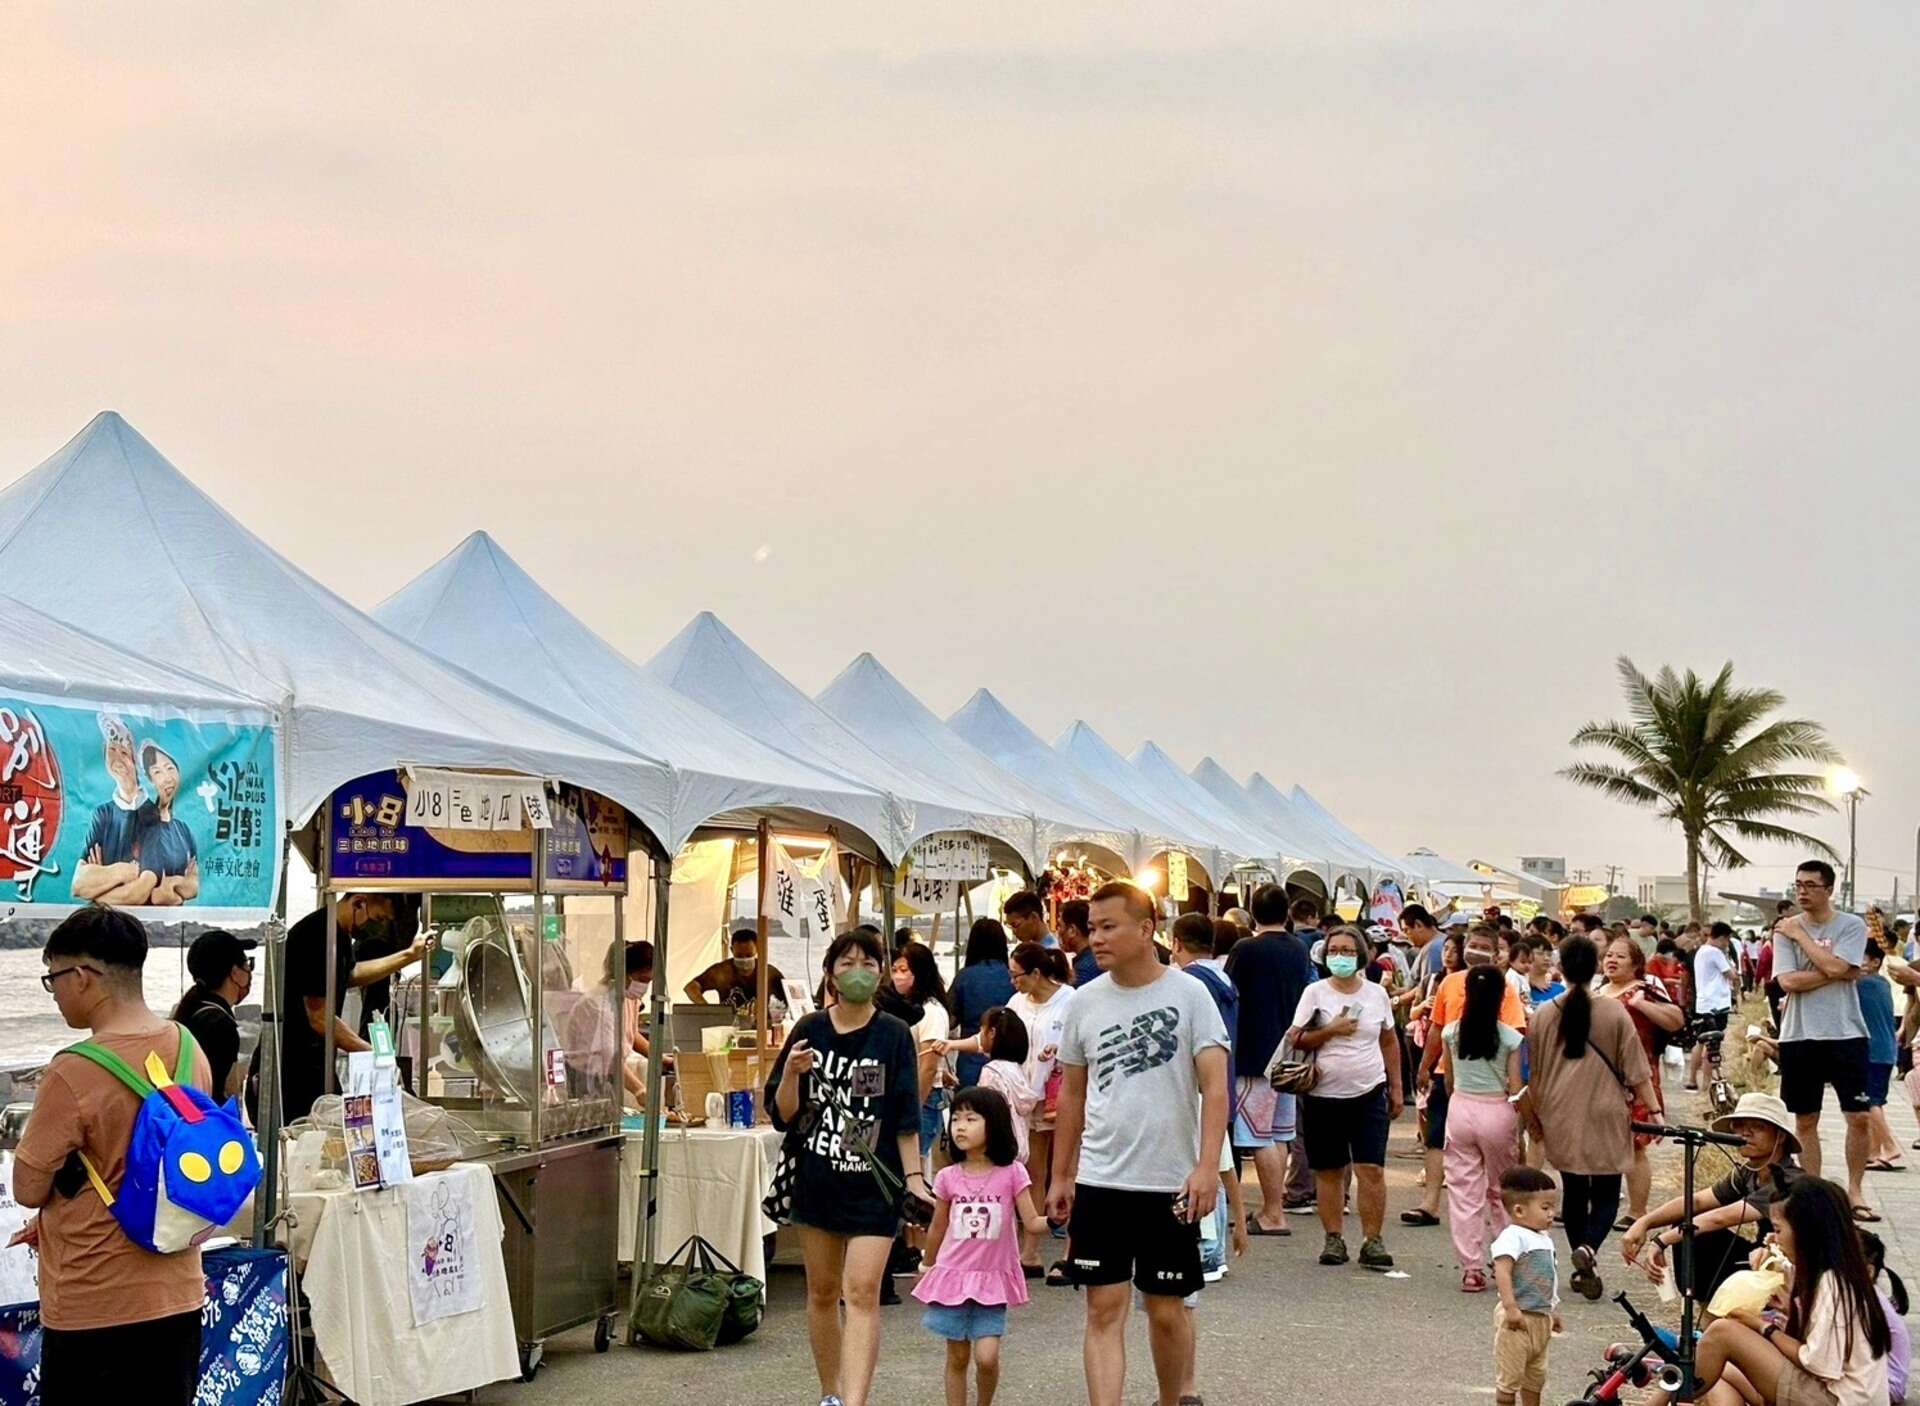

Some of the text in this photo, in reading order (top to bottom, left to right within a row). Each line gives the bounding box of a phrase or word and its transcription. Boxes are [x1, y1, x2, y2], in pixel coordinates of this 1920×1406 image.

[245, 791, 266, 803] PLUS
[342, 795, 403, 826] 小8
[955, 1195, 1002, 1204] LOVELY
